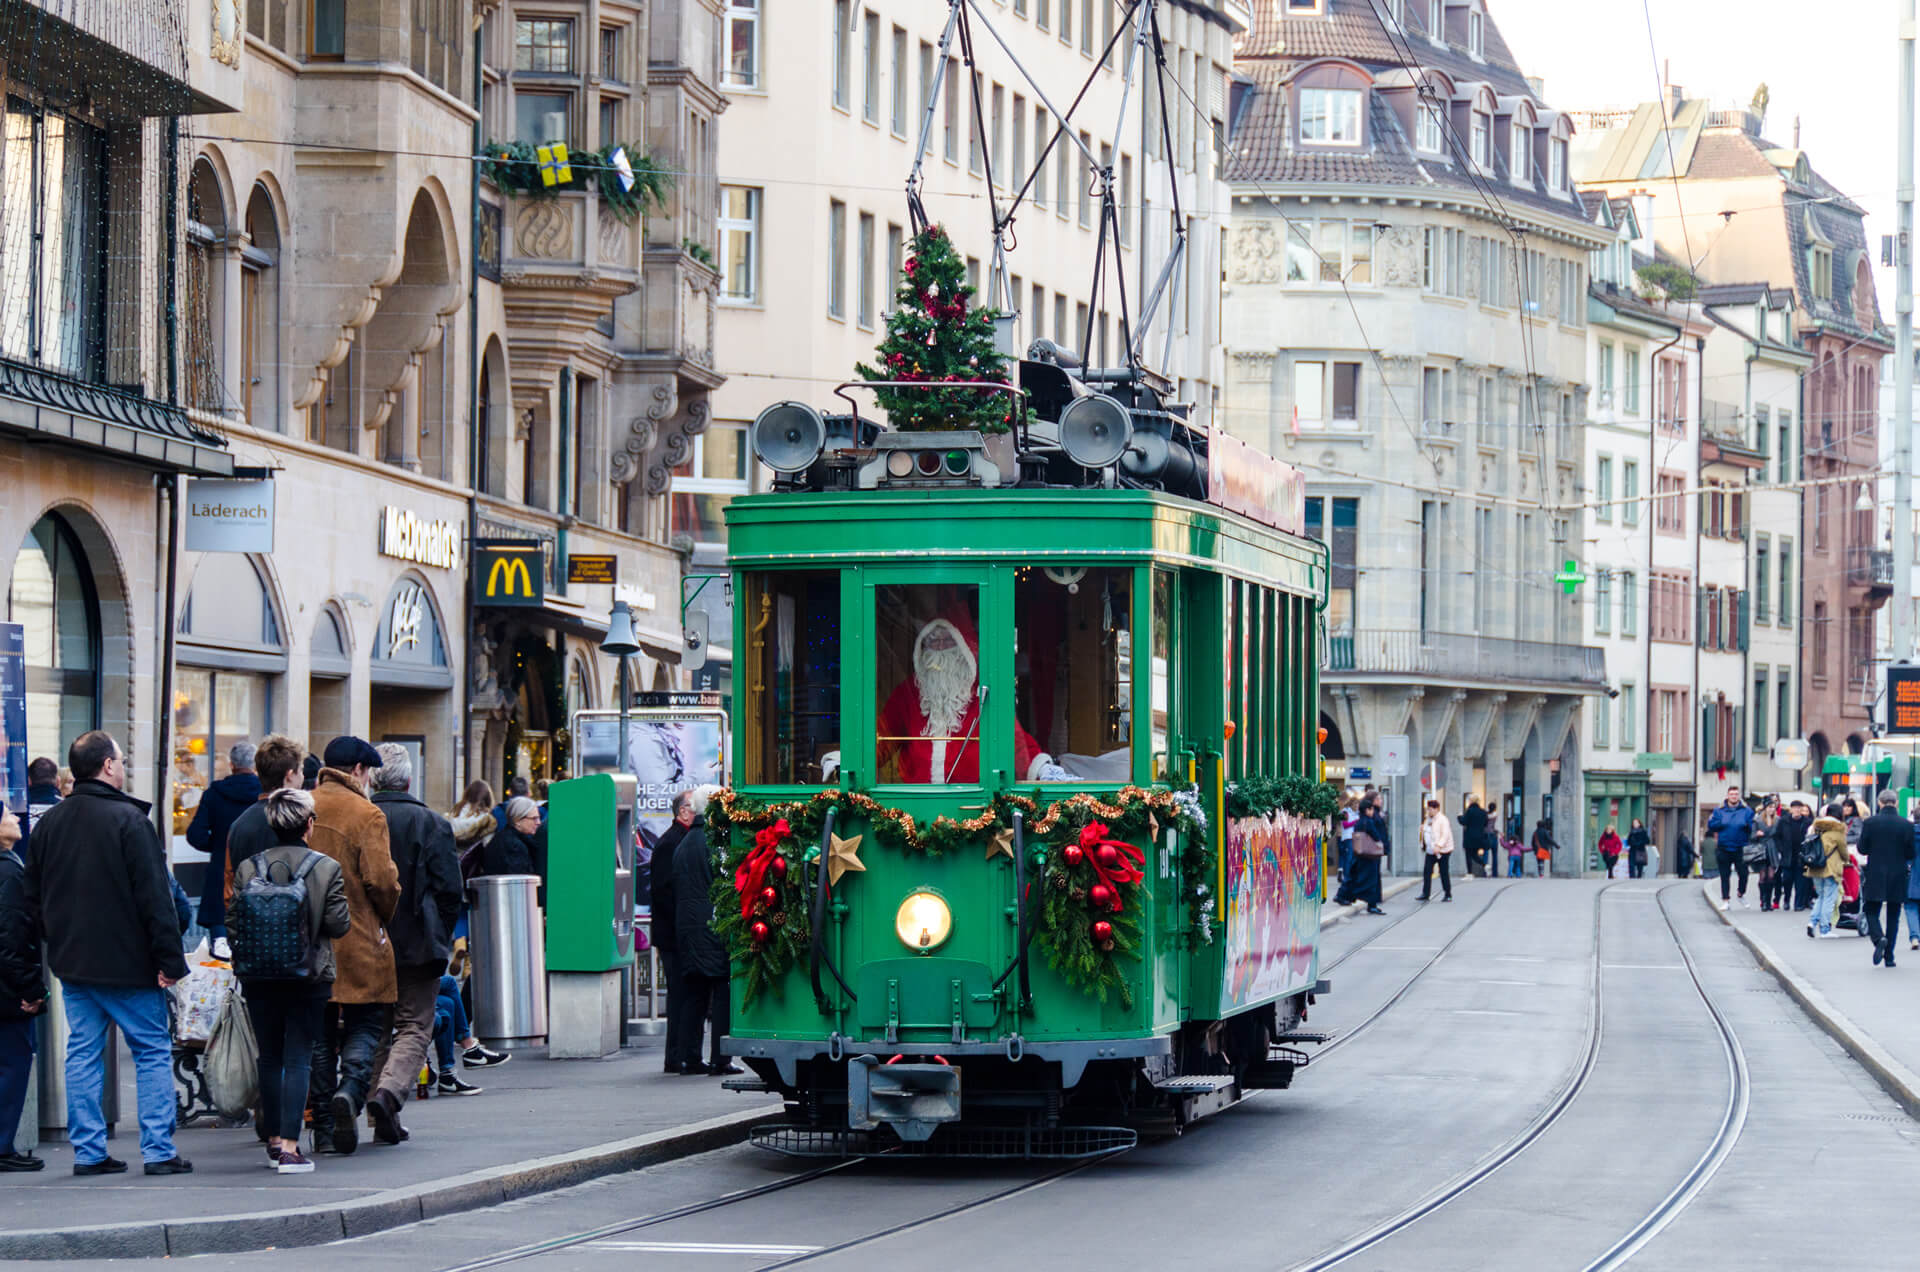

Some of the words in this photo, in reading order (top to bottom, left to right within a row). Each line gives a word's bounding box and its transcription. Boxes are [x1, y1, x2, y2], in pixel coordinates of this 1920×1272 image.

[192, 503, 267, 518] Läderach
[384, 505, 459, 570] McDonald's
[661, 784, 678, 795] ZU
